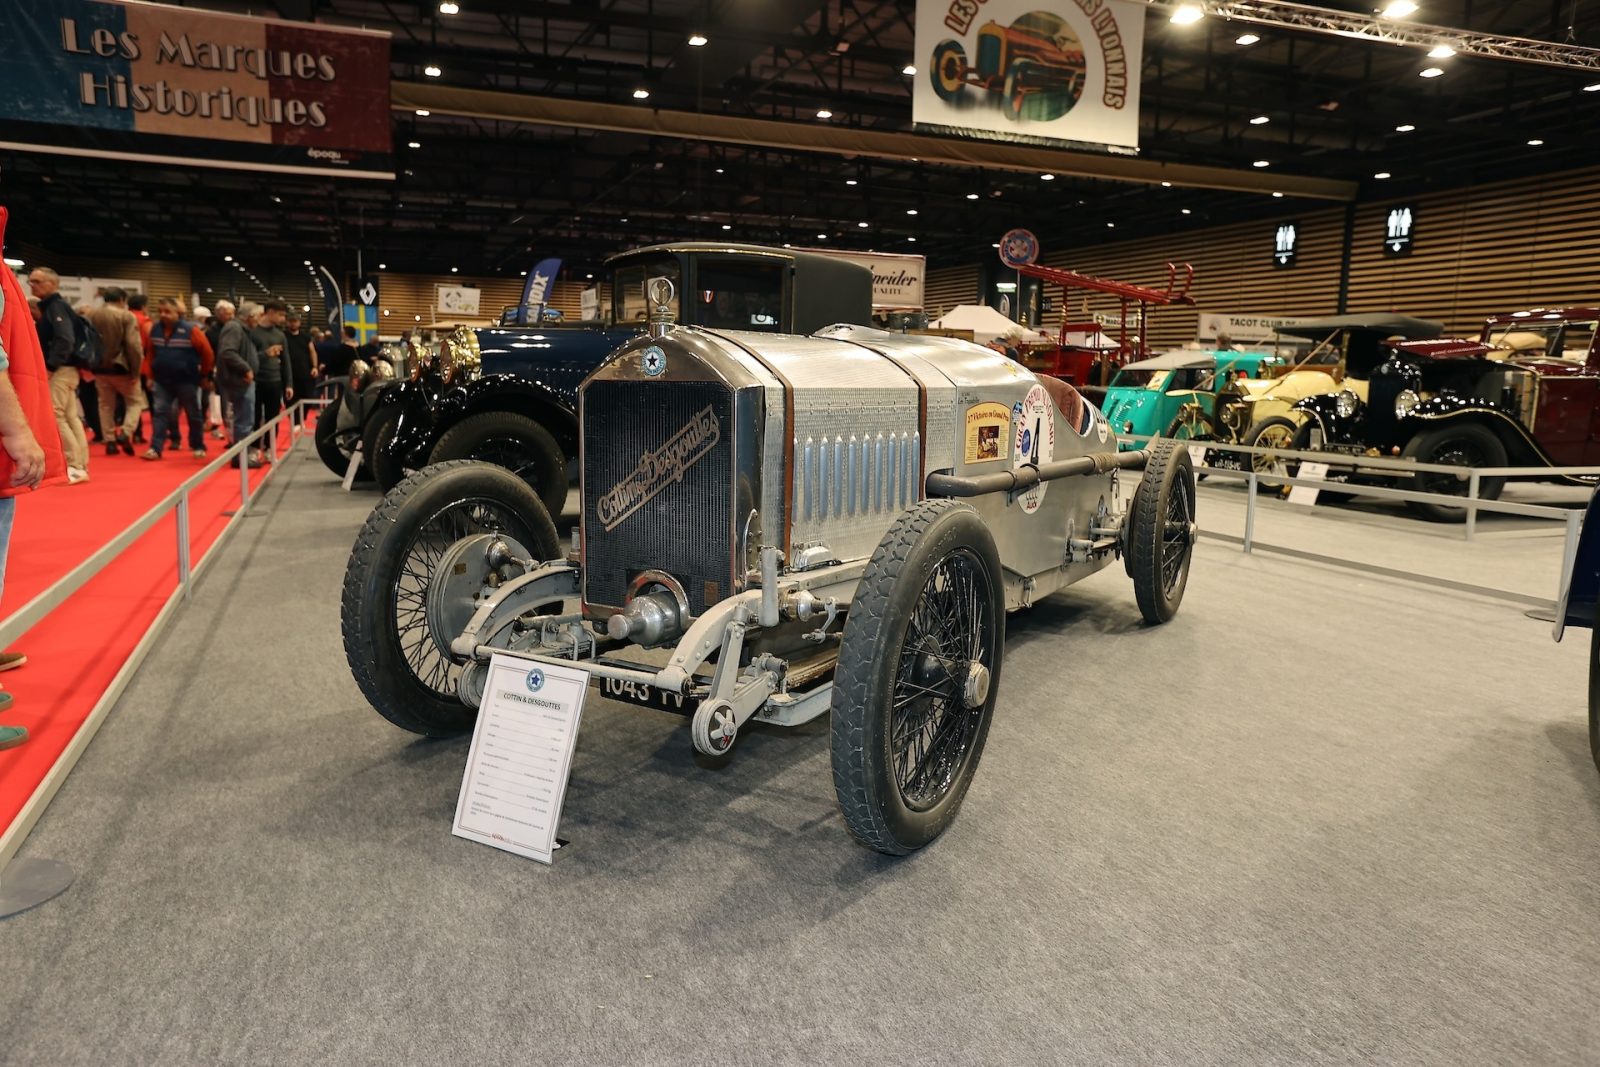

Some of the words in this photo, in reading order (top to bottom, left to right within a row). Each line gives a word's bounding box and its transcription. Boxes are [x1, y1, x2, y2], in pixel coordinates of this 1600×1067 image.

[60, 17, 140, 60] Les
[155, 30, 337, 81] Marques
[944, 0, 978, 36] LES
[1091, 7, 1127, 110] LYONNAIS
[79, 71, 328, 127] Historiques
[1229, 318, 1258, 327] TACOT
[1259, 320, 1283, 328] CLUB
[503, 692, 522, 704] COTTIN
[522, 696, 527, 704] &
[527, 696, 561, 711] DESGOUTTES
[605, 677, 650, 701] 1043
